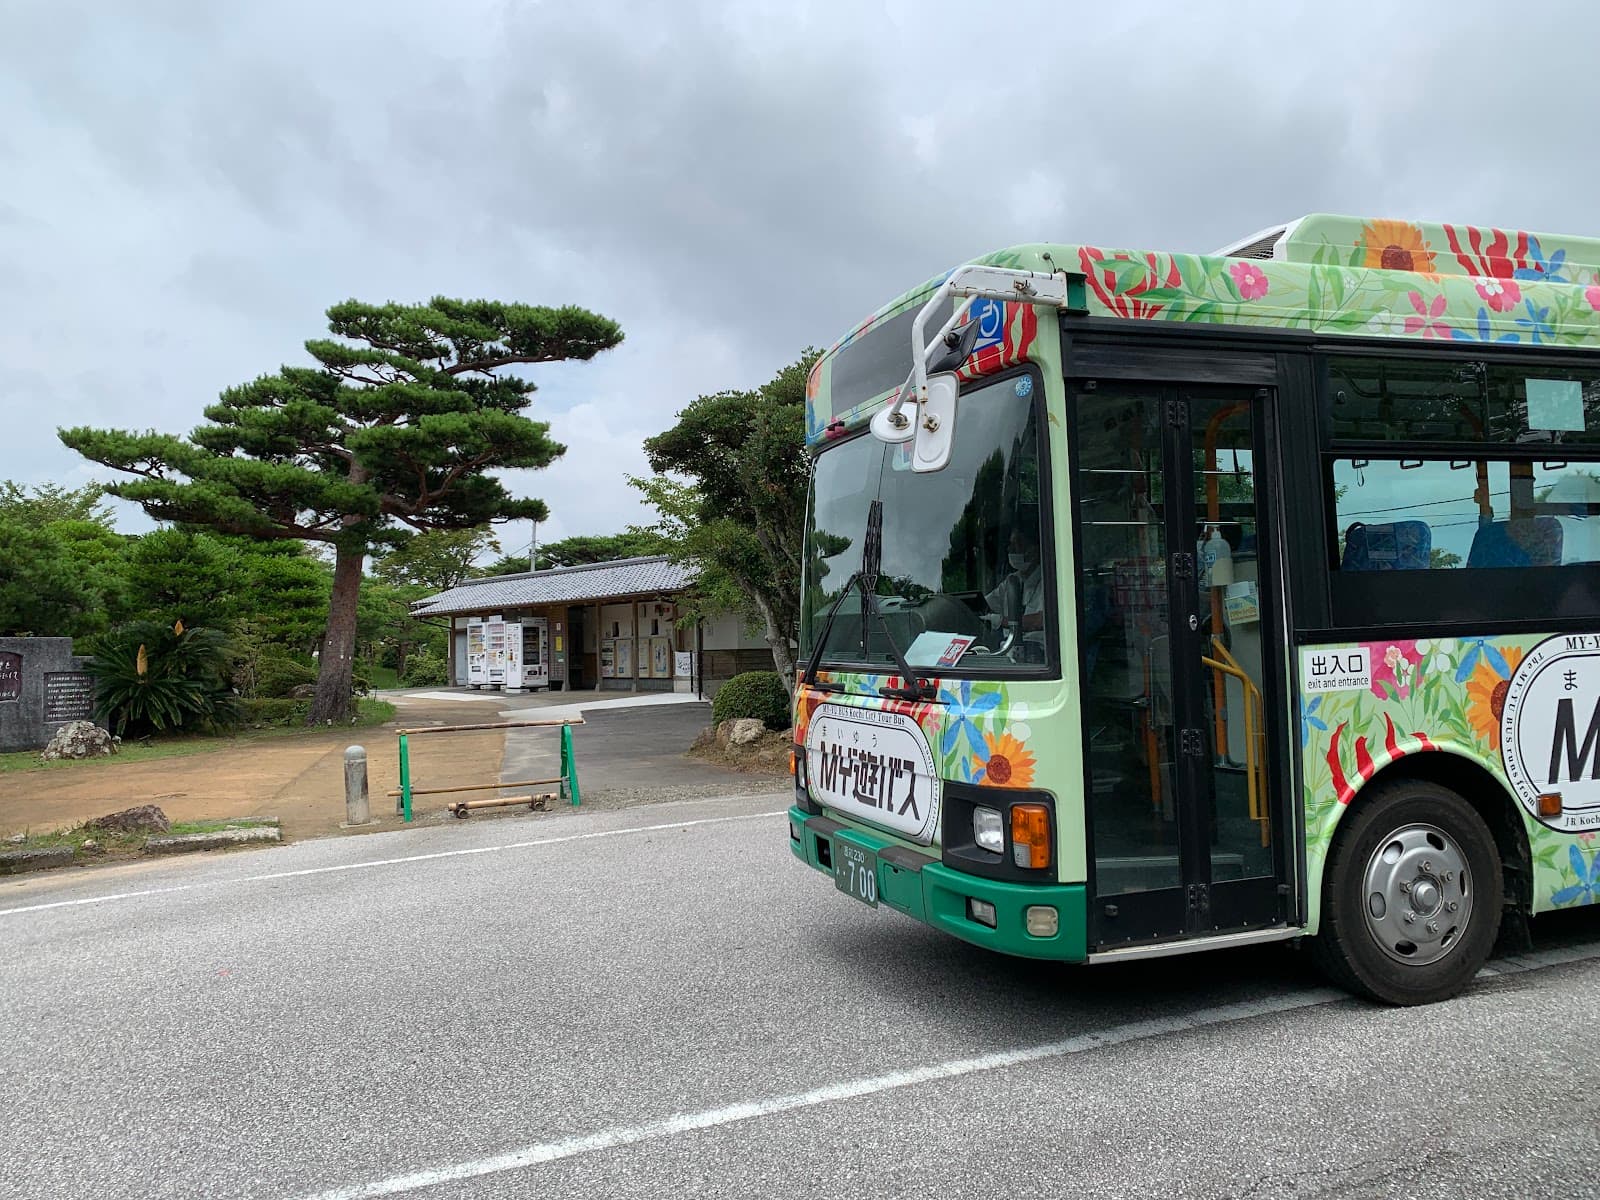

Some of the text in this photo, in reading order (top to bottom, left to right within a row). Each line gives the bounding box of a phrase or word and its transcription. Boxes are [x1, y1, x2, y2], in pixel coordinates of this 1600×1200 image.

[1312, 655, 1362, 676] 出入口
[1308, 676, 1369, 689] exit and entrance
[1563, 669, 1578, 691] ま
[849, 708, 865, 719] Kochi
[865, 710, 876, 722] City
[877, 712, 892, 722] Tour
[893, 714, 905, 726] Bus
[1505, 651, 1545, 808] The MY-YU BUS runs from
[1564, 817, 1576, 827] JR
